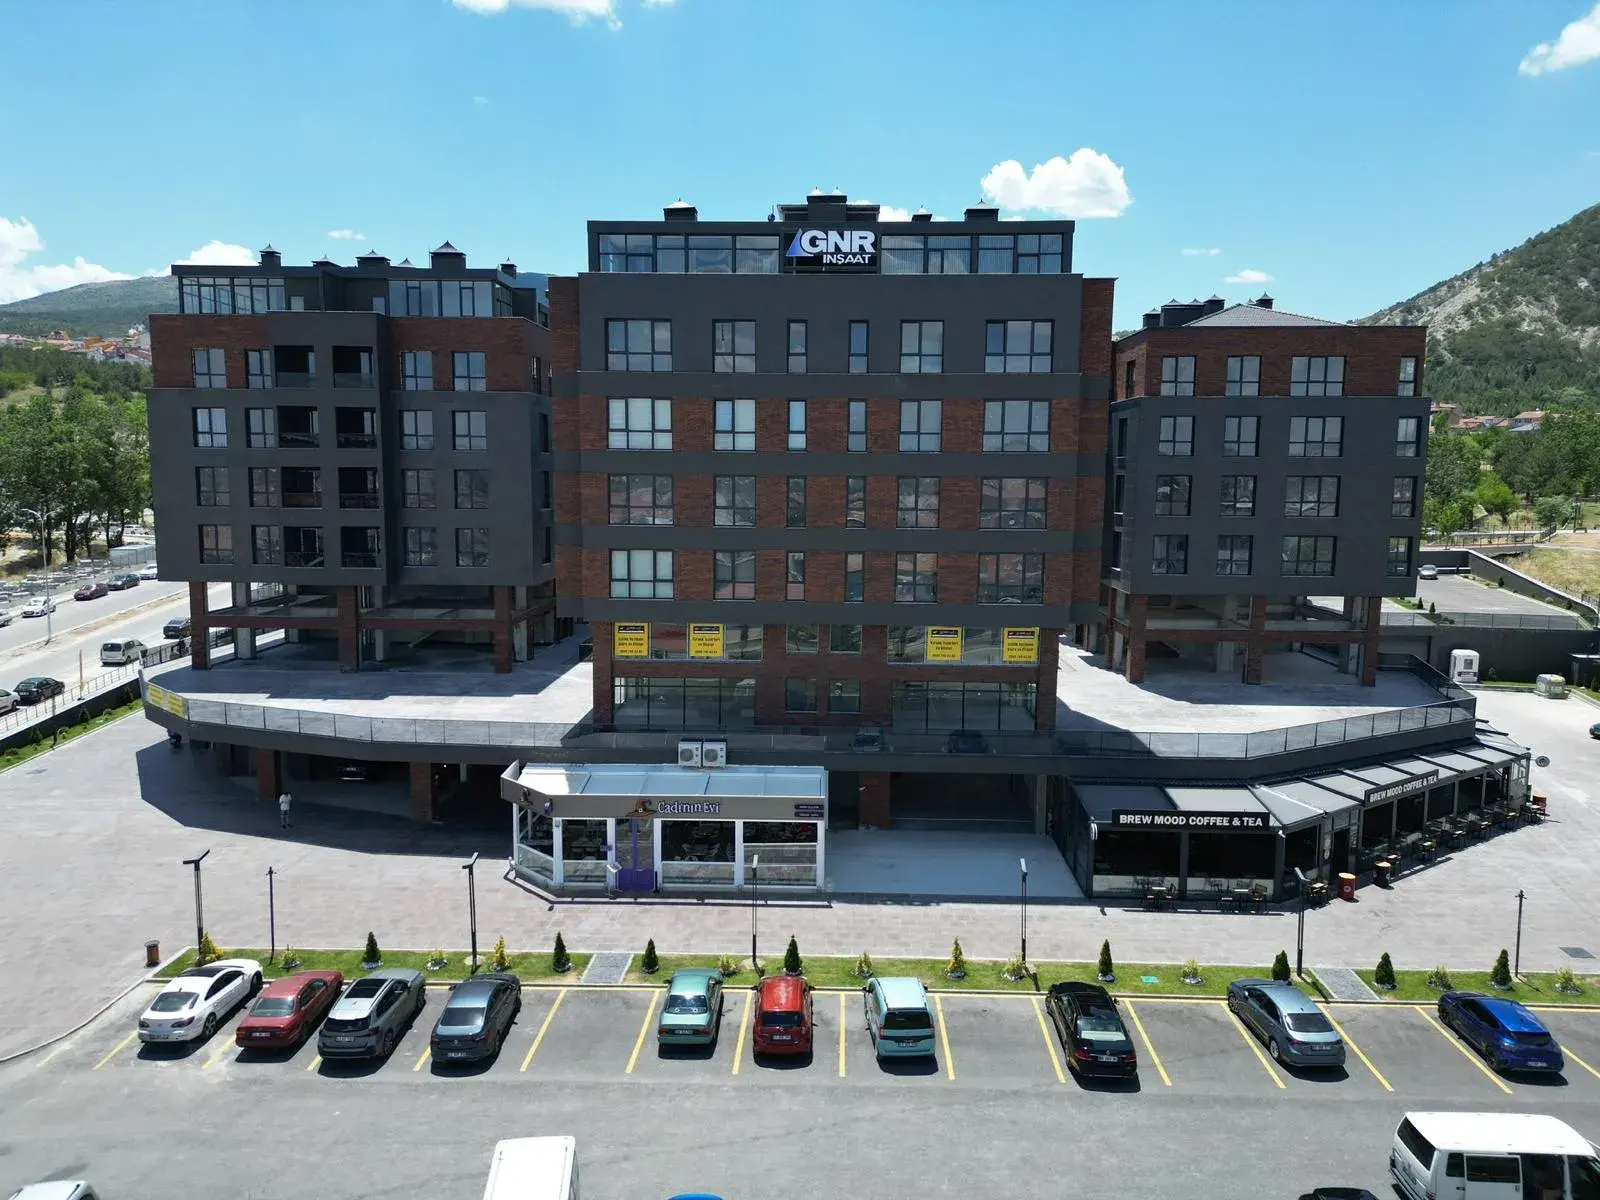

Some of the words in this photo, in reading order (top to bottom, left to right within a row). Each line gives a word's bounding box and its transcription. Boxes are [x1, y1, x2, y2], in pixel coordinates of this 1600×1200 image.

[801, 230, 876, 253] GNR
[1369, 790, 1386, 802] BREW
[1387, 786, 1403, 797] MOOD
[1403, 780, 1422, 792] COFFEE
[1427, 776, 1437, 785] TEA
[703, 802, 720, 813] Evi
[1119, 814, 1152, 824] BREW
[1154, 815, 1187, 825] MOOD
[1188, 816, 1230, 826] COFFEE
[1231, 817, 1241, 826] &
[1242, 817, 1263, 827] TEA
